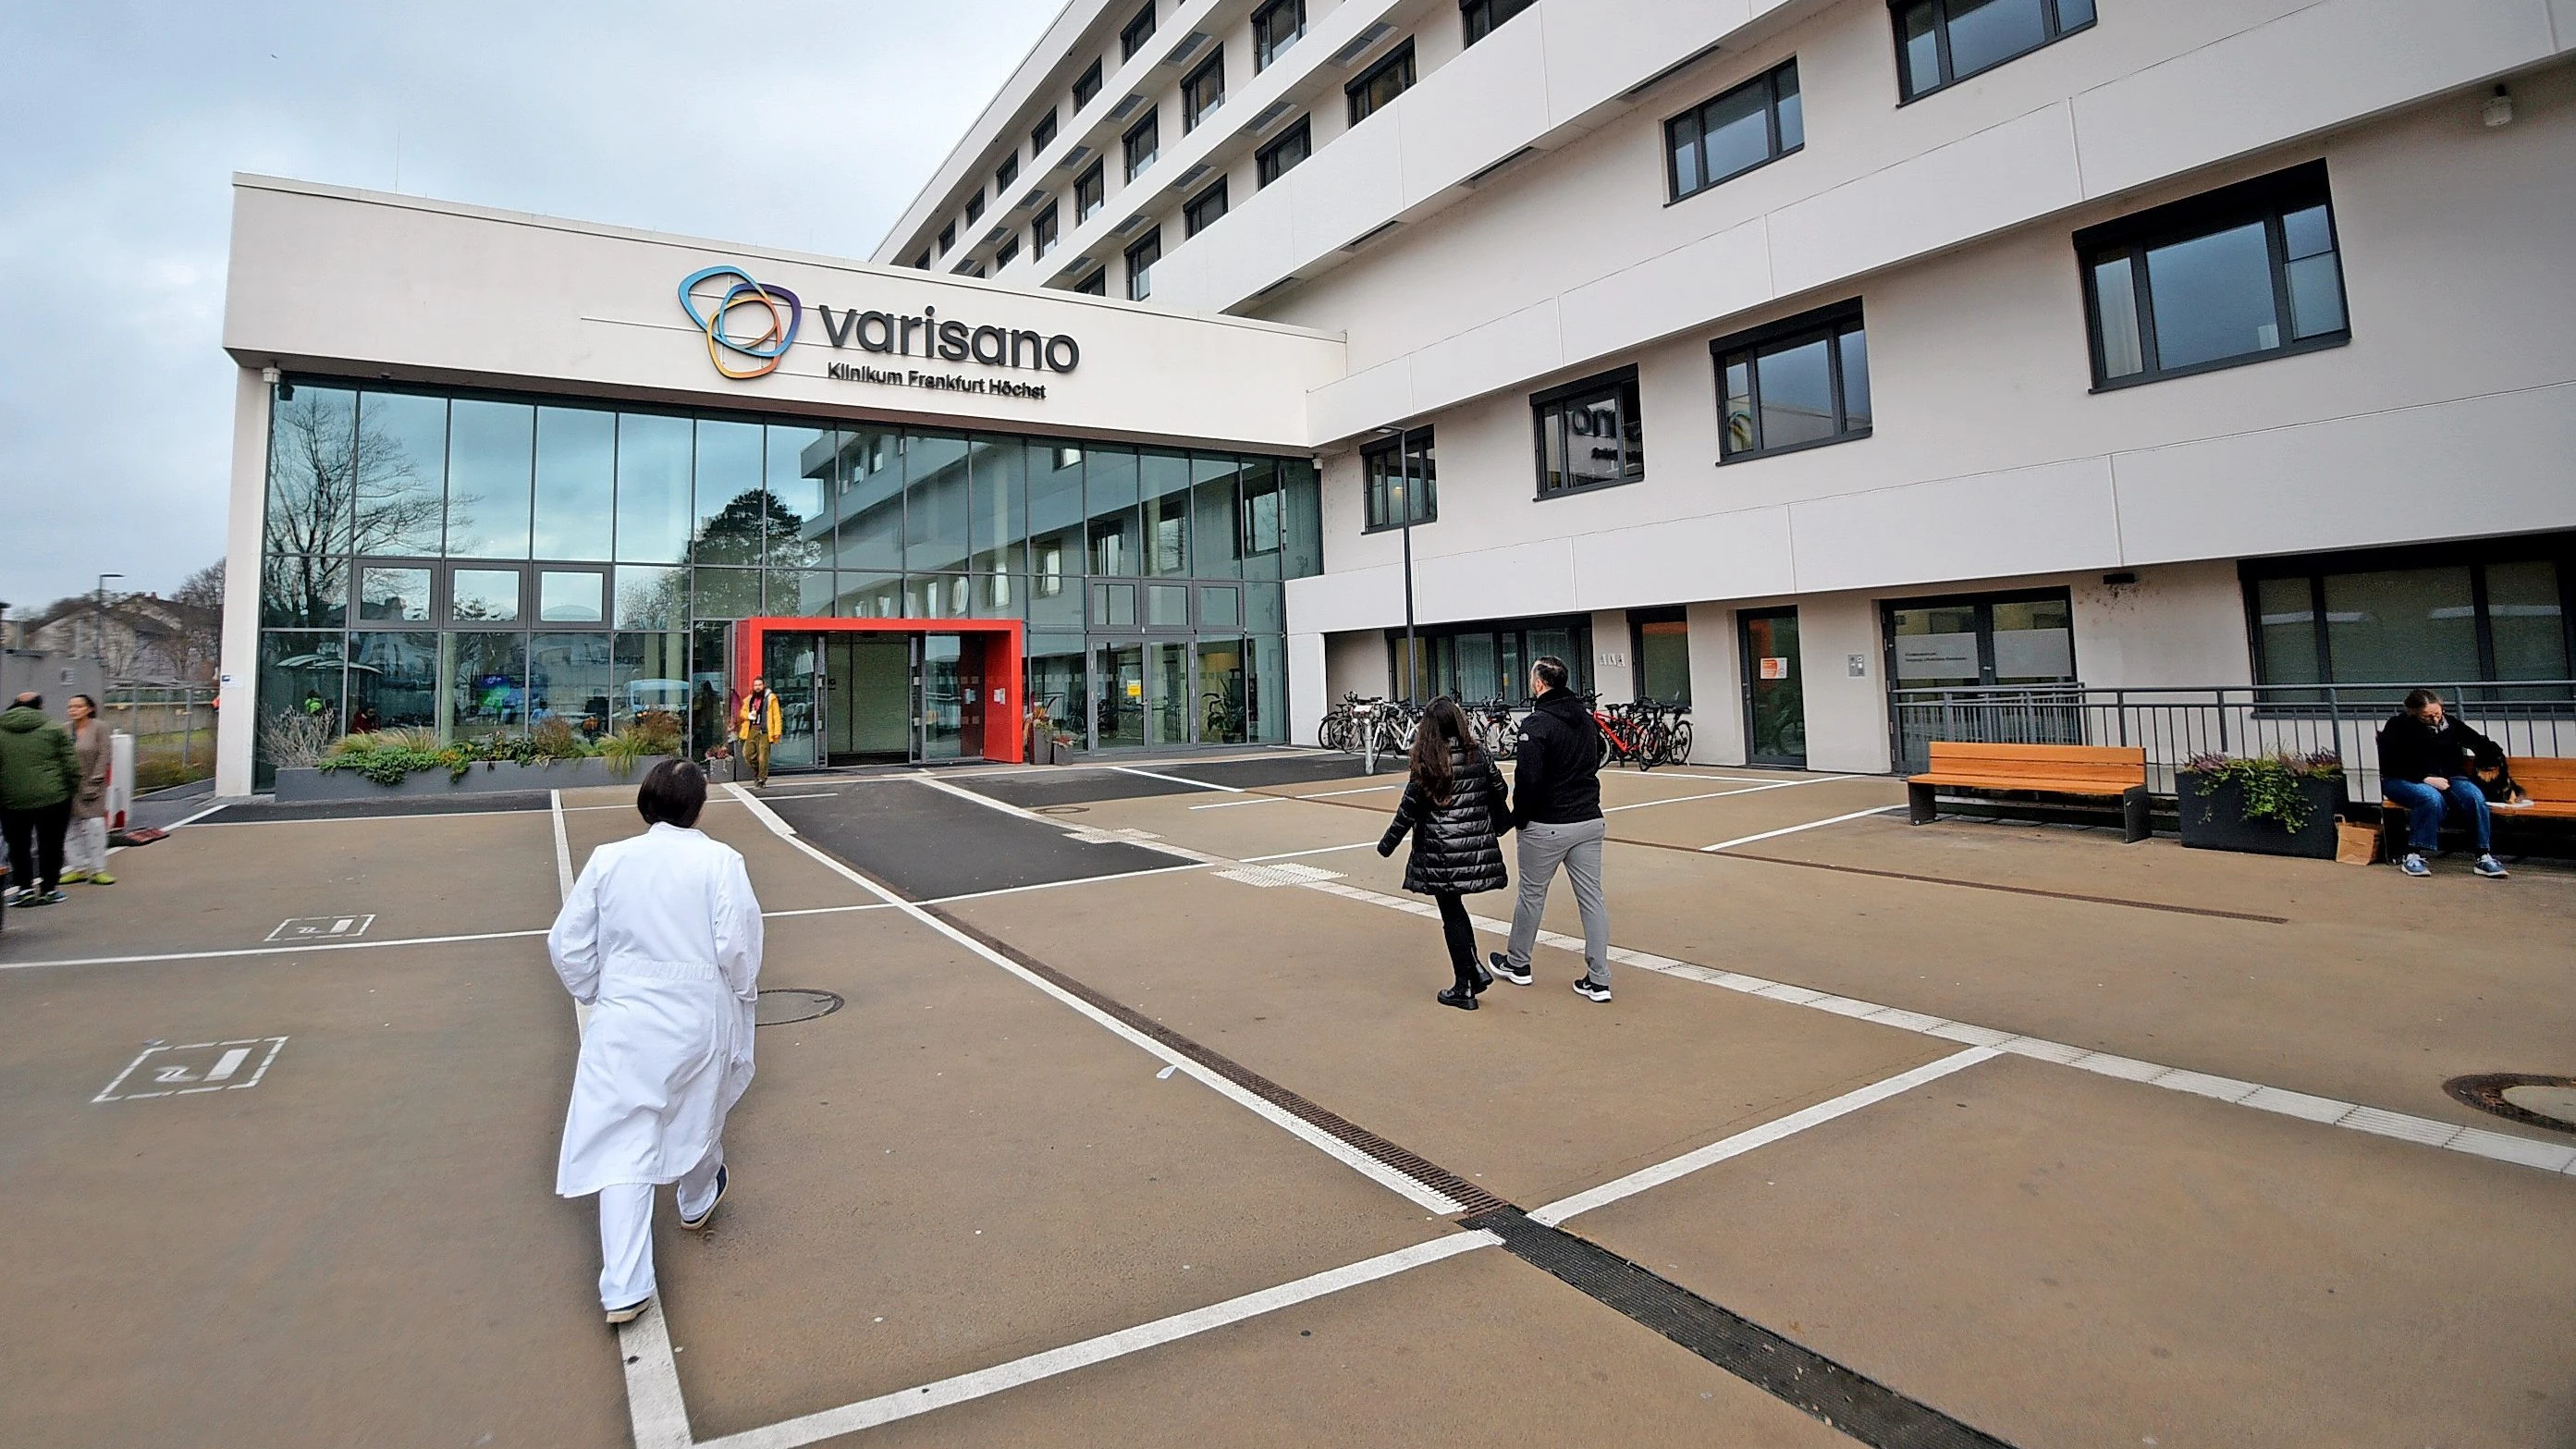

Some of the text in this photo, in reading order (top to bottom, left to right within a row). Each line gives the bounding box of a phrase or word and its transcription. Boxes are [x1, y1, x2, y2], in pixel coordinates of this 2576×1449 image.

[819, 305, 1080, 373] varisano
[828, 362, 1046, 399] Klinikum Frankfurt Höchst
